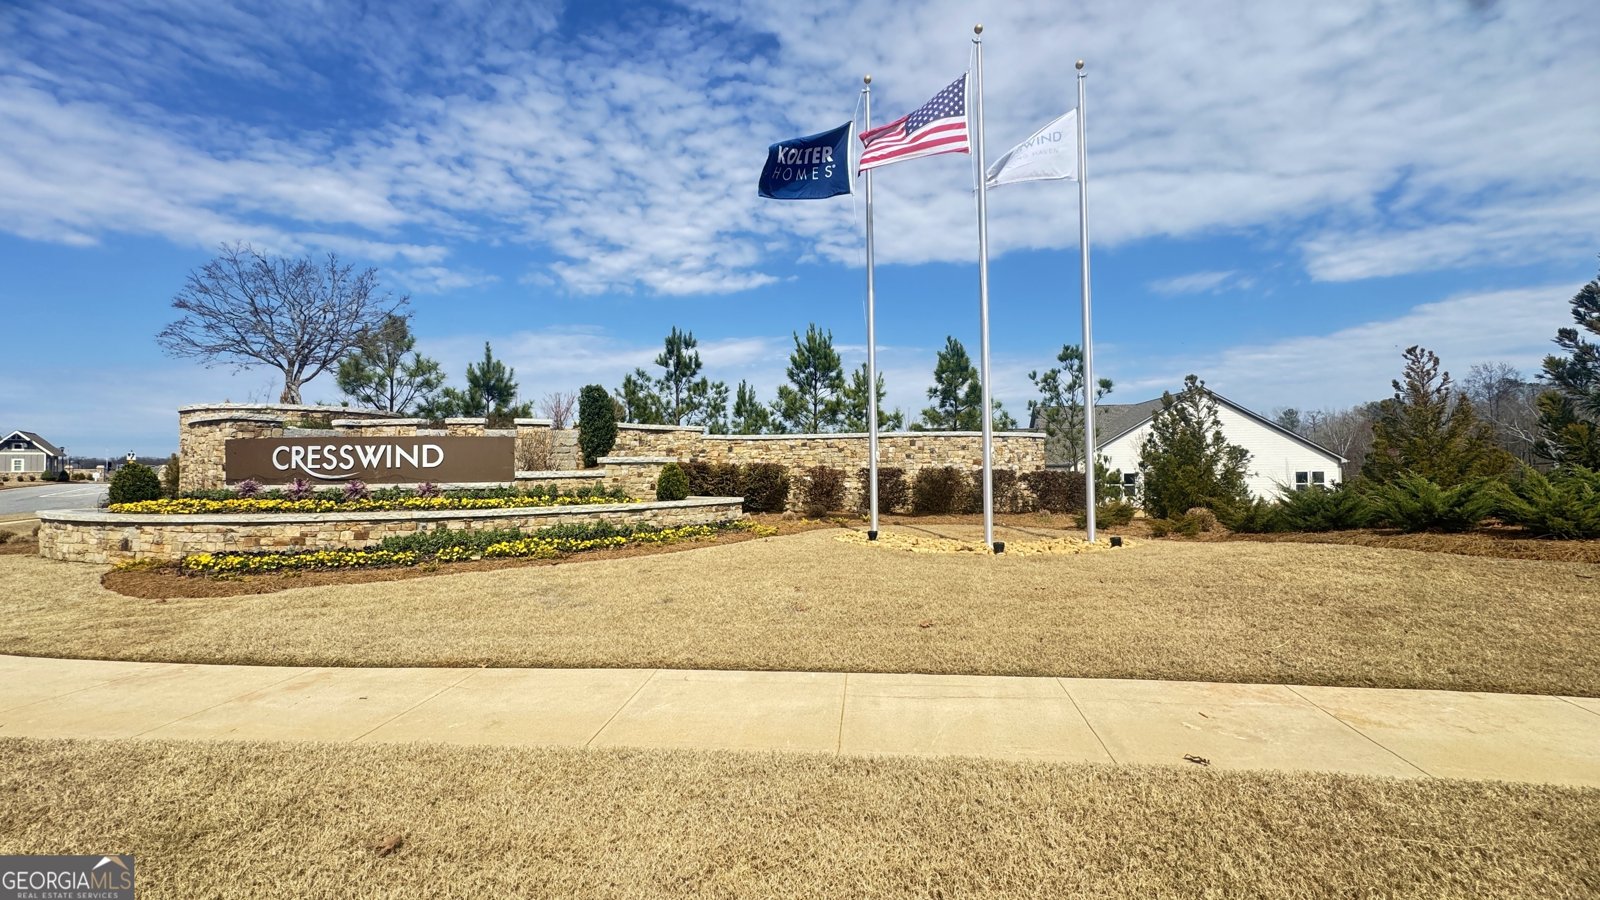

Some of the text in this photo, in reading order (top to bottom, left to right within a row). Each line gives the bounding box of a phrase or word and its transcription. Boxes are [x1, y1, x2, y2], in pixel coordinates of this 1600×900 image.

[777, 145, 833, 165] KOLTER
[772, 165, 834, 181] HOMES
[272, 444, 444, 479] CRESSWIND
